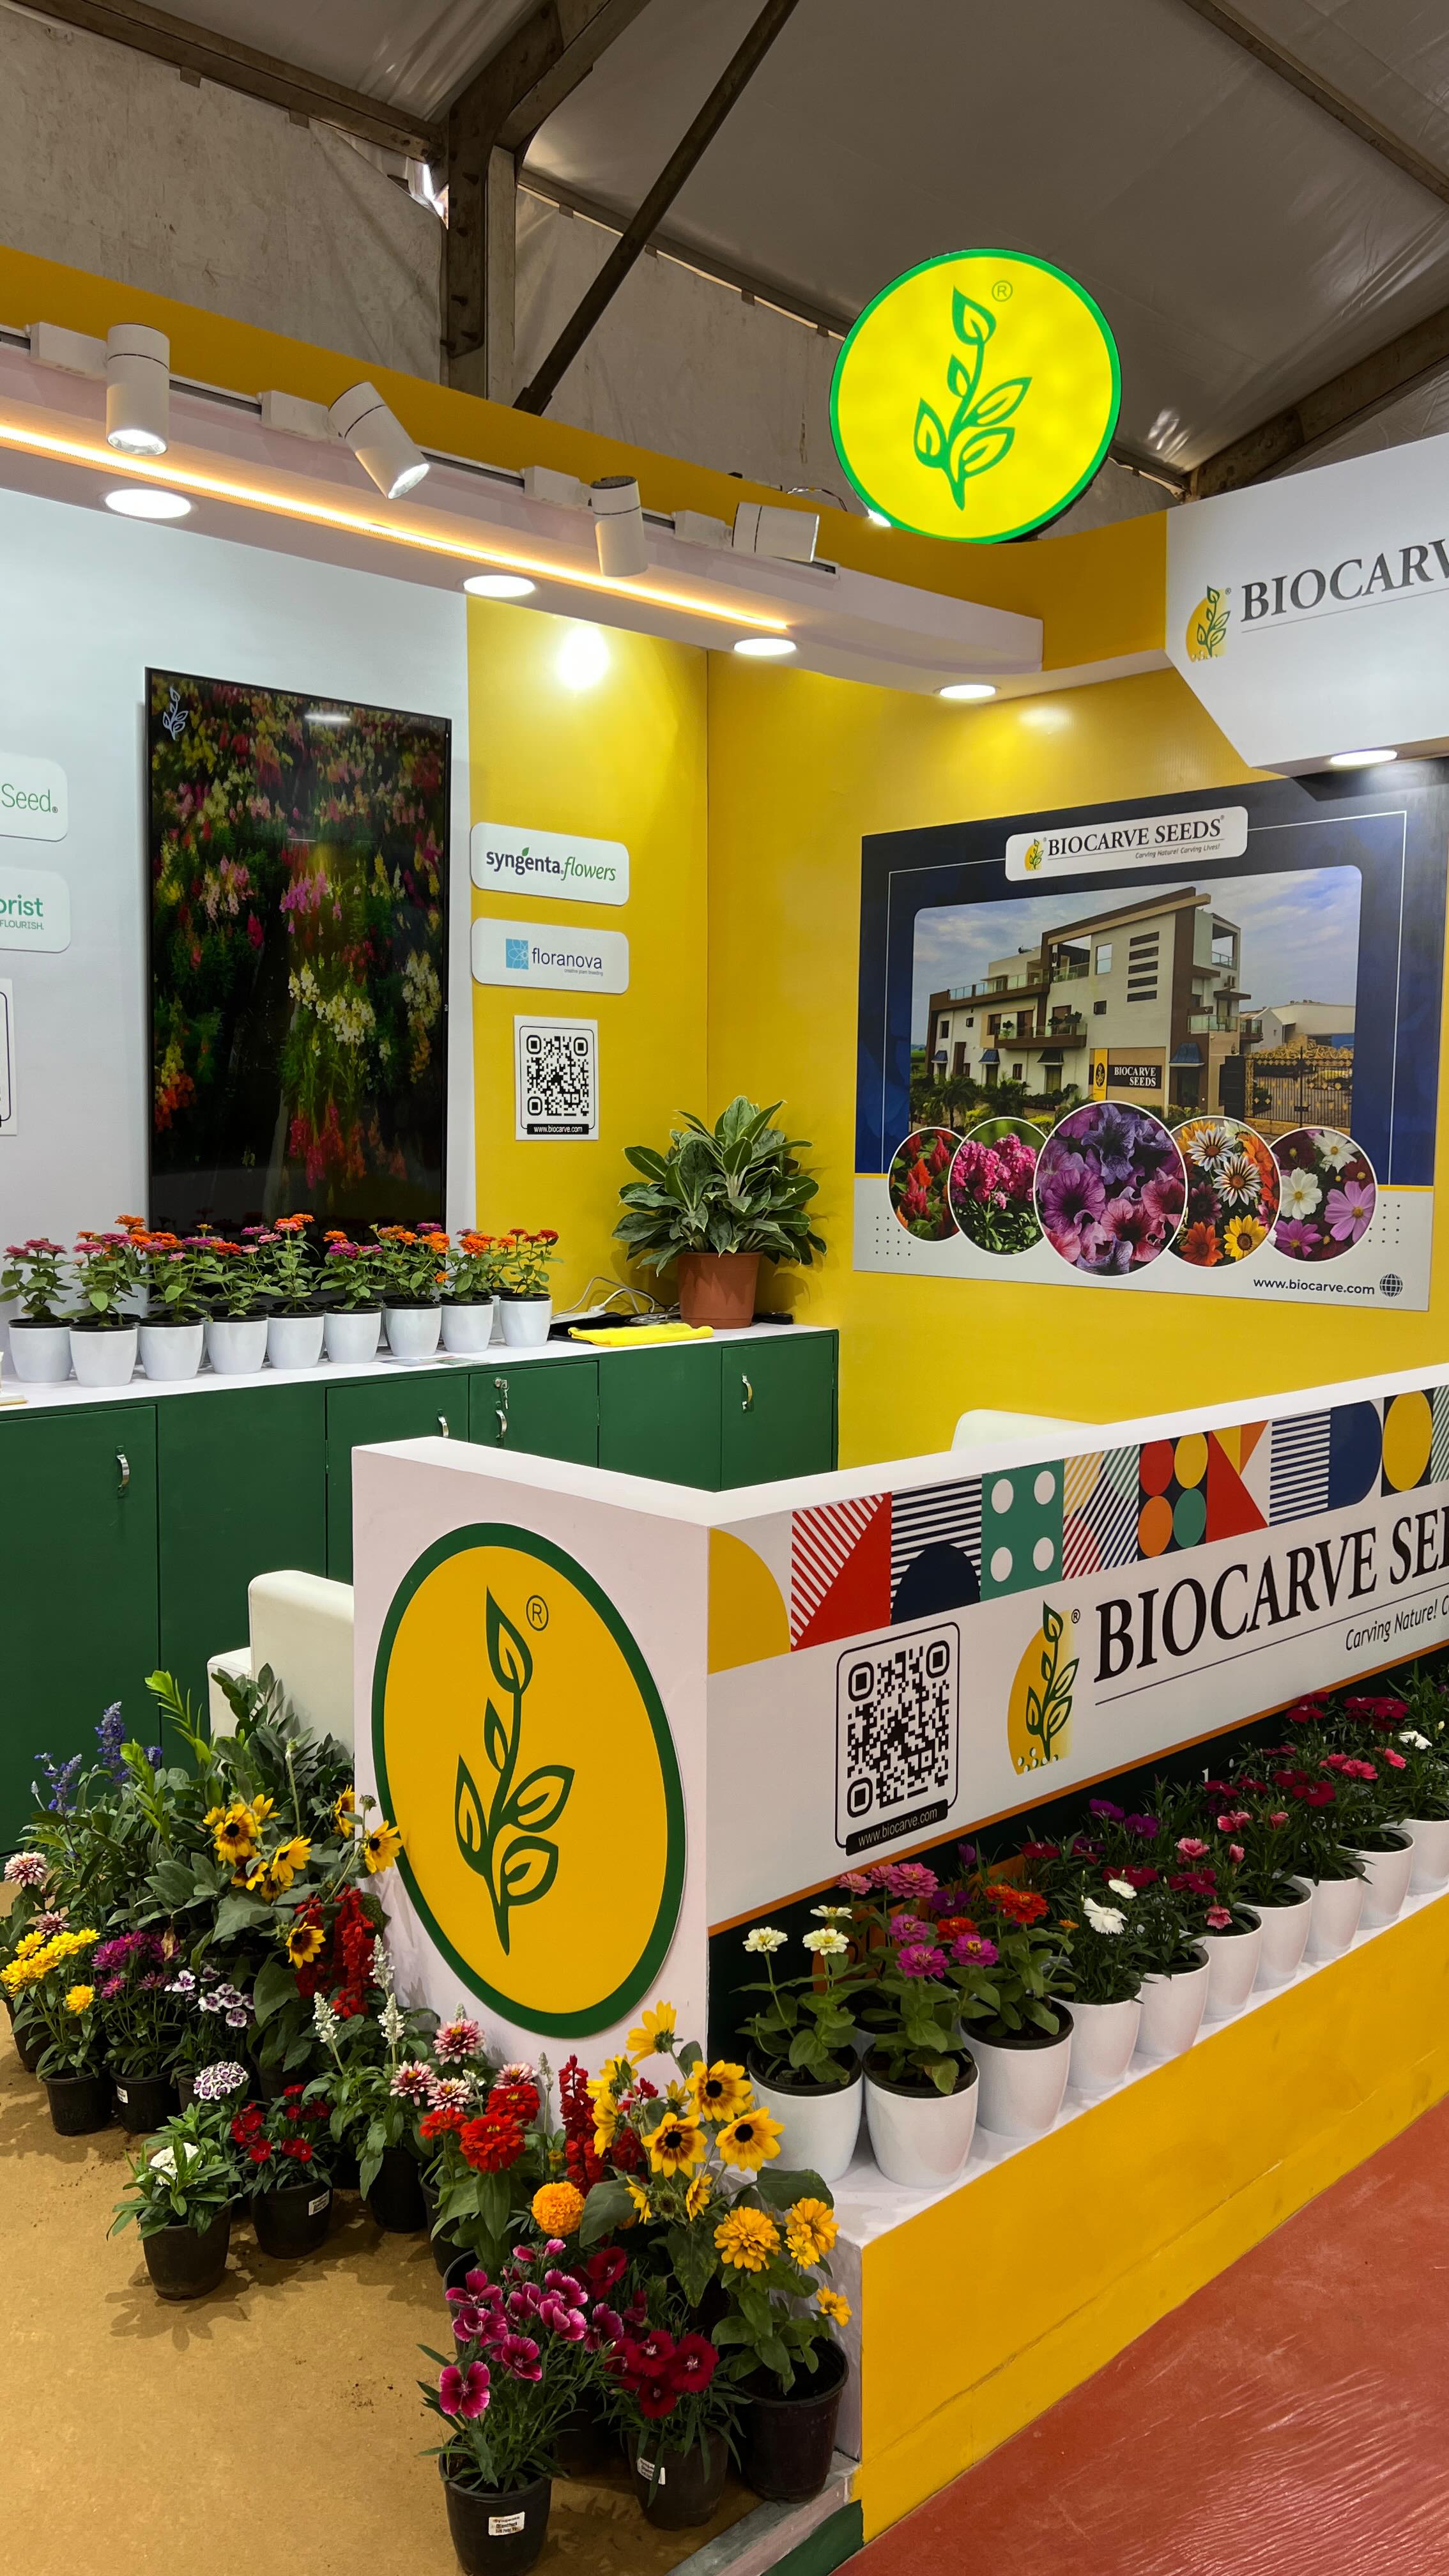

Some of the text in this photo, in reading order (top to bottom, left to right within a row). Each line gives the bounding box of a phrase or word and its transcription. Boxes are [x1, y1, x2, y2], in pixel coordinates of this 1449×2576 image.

[1048, 827, 1150, 856] BIOCARVE
[1135, 851, 1156, 859] Carving
[1181, 846, 1202, 854] Carving
[560, 856, 617, 881] flowers
[532, 947, 602, 969] floranova
[1114, 1066, 1156, 1077] BIOCARVE
[1129, 1077, 1156, 1087] SEEDS
[533, 1124, 583, 1133] www.biocarve.com
[1253, 1278, 1375, 1295] www.biocarve.com
[1093, 1526, 1377, 1683] BIOCARVE
[1346, 1620, 1391, 1651] Carving
[1394, 1598, 1438, 1634] Nature!
[858, 1808, 938, 1847] www.biocarve.com
